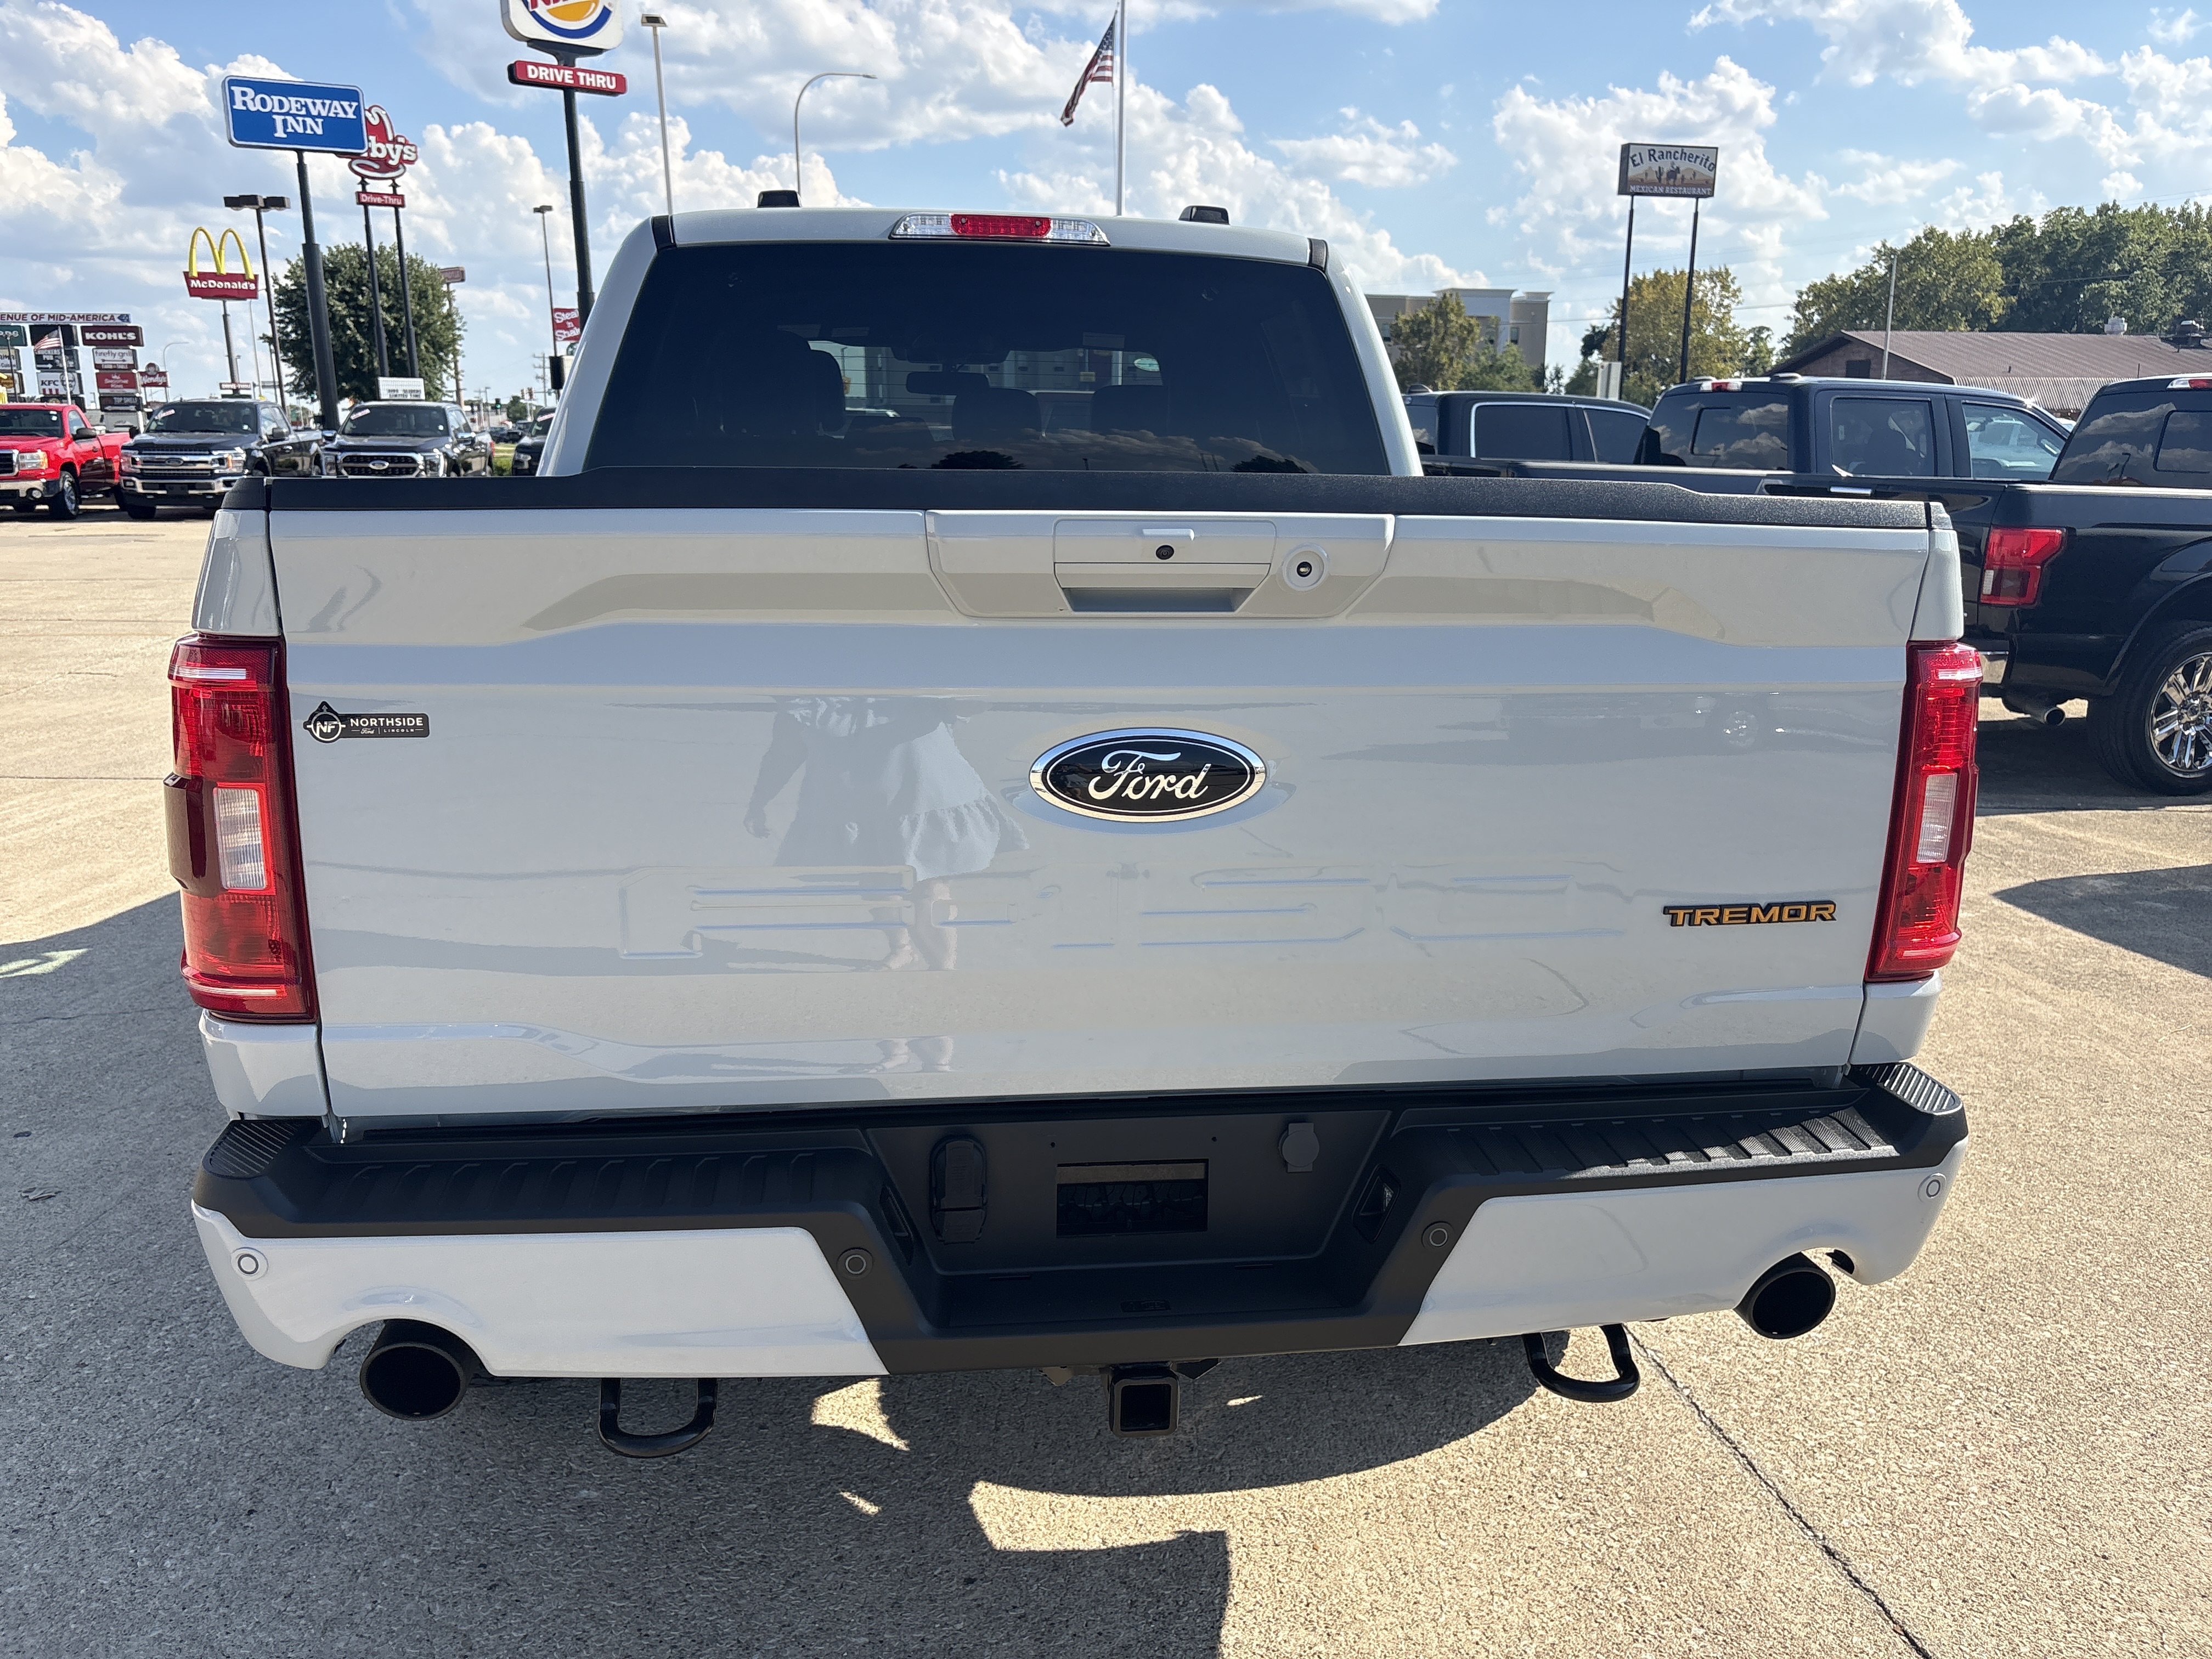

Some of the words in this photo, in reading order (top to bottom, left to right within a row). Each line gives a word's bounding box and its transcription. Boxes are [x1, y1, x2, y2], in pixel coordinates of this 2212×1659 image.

[526, 65, 574, 84] DRIVE
[576, 71, 617, 89] THRU
[272, 114, 324, 138] INN
[1630, 152, 1644, 167] El
[1647, 148, 1716, 172] Rancherito
[1629, 184, 1664, 194] MEXICAN
[1664, 187, 1712, 195] RESTAURANT
[360, 194, 402, 205] Drive-Thru
[190, 279, 256, 290] McDonald's
[84, 332, 137, 341] KOHL'S
[95, 350, 116, 359] firefly
[117, 350, 132, 359] grill
[350, 717, 424, 727] NORTHSIDE
[1088, 749, 1212, 800] Ford
[1663, 900, 1837, 927] TREMOR
